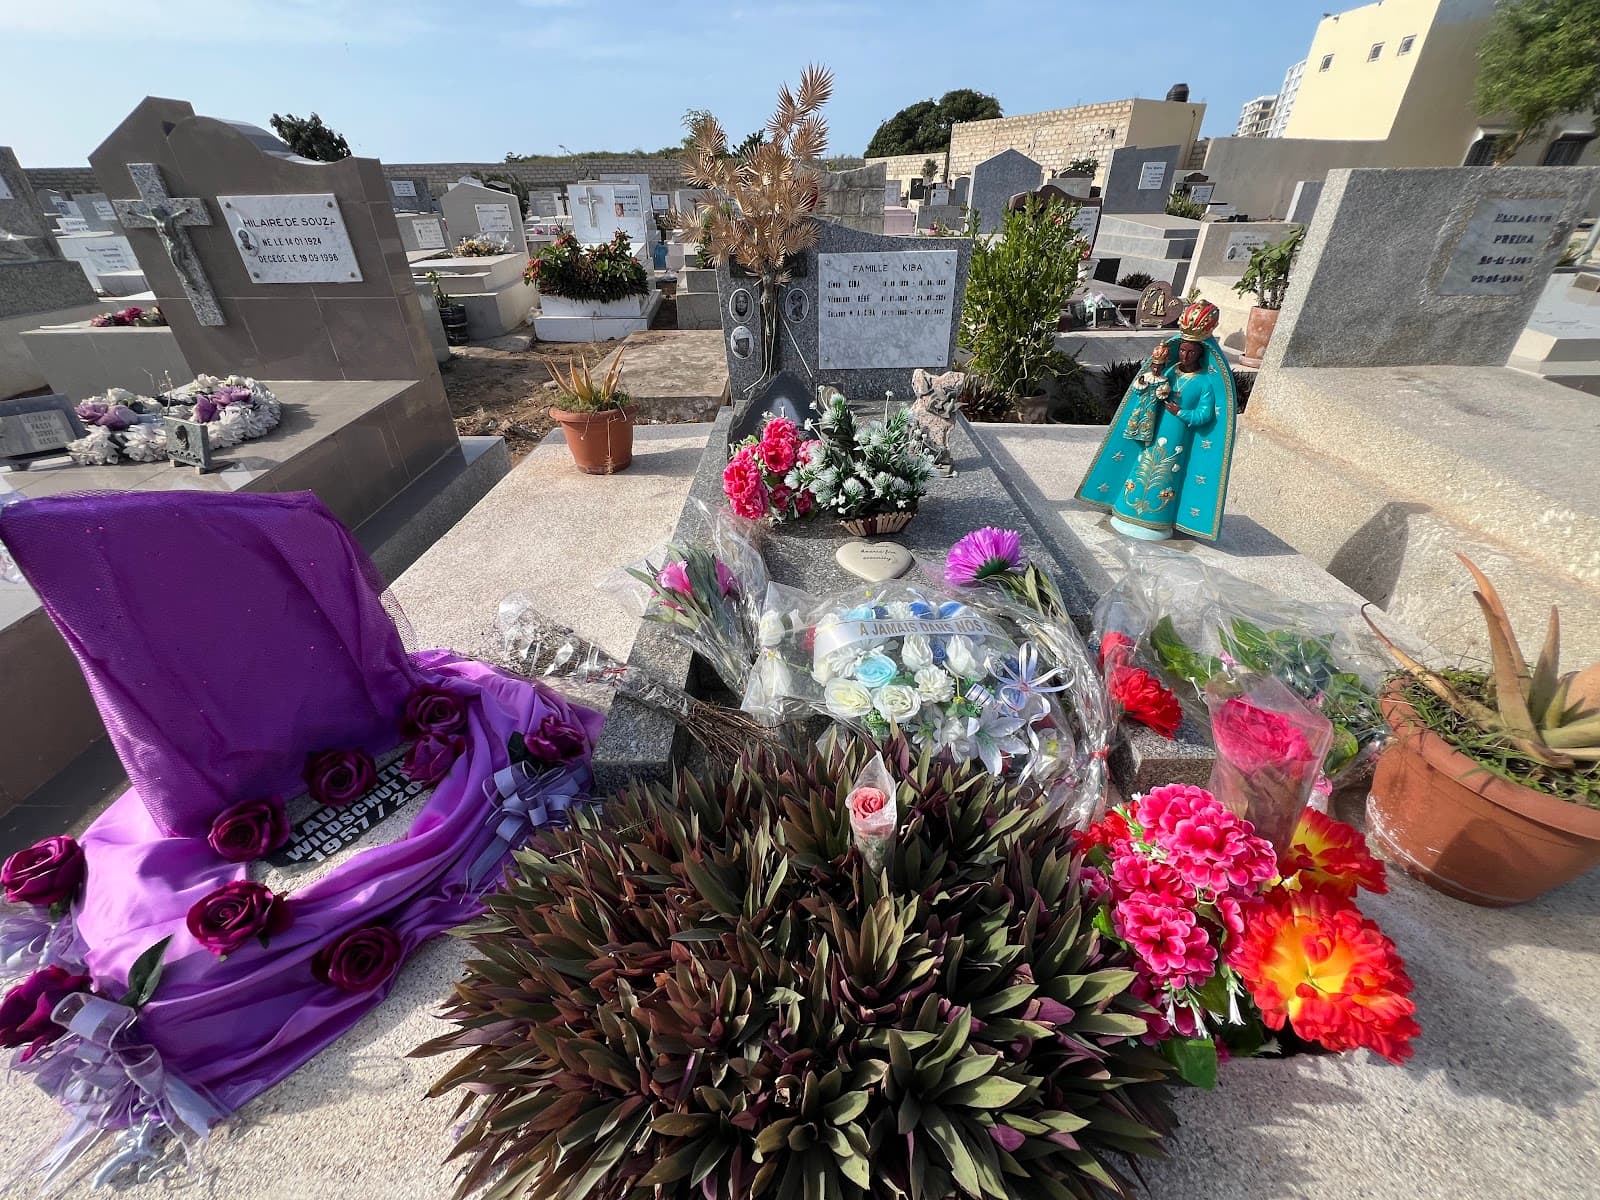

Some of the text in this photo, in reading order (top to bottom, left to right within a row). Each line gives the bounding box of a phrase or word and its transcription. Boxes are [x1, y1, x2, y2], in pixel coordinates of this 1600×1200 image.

[242, 217, 284, 228] HILAIRE
[286, 217, 300, 227] DE
[288, 254, 297, 263] LE
[852, 263, 923, 273] FAMILLE KIBA
[872, 621, 918, 636] JAMAIS
[919, 622, 952, 633] DANS
[955, 619, 982, 633] NOS
[308, 815, 370, 862] 1957
